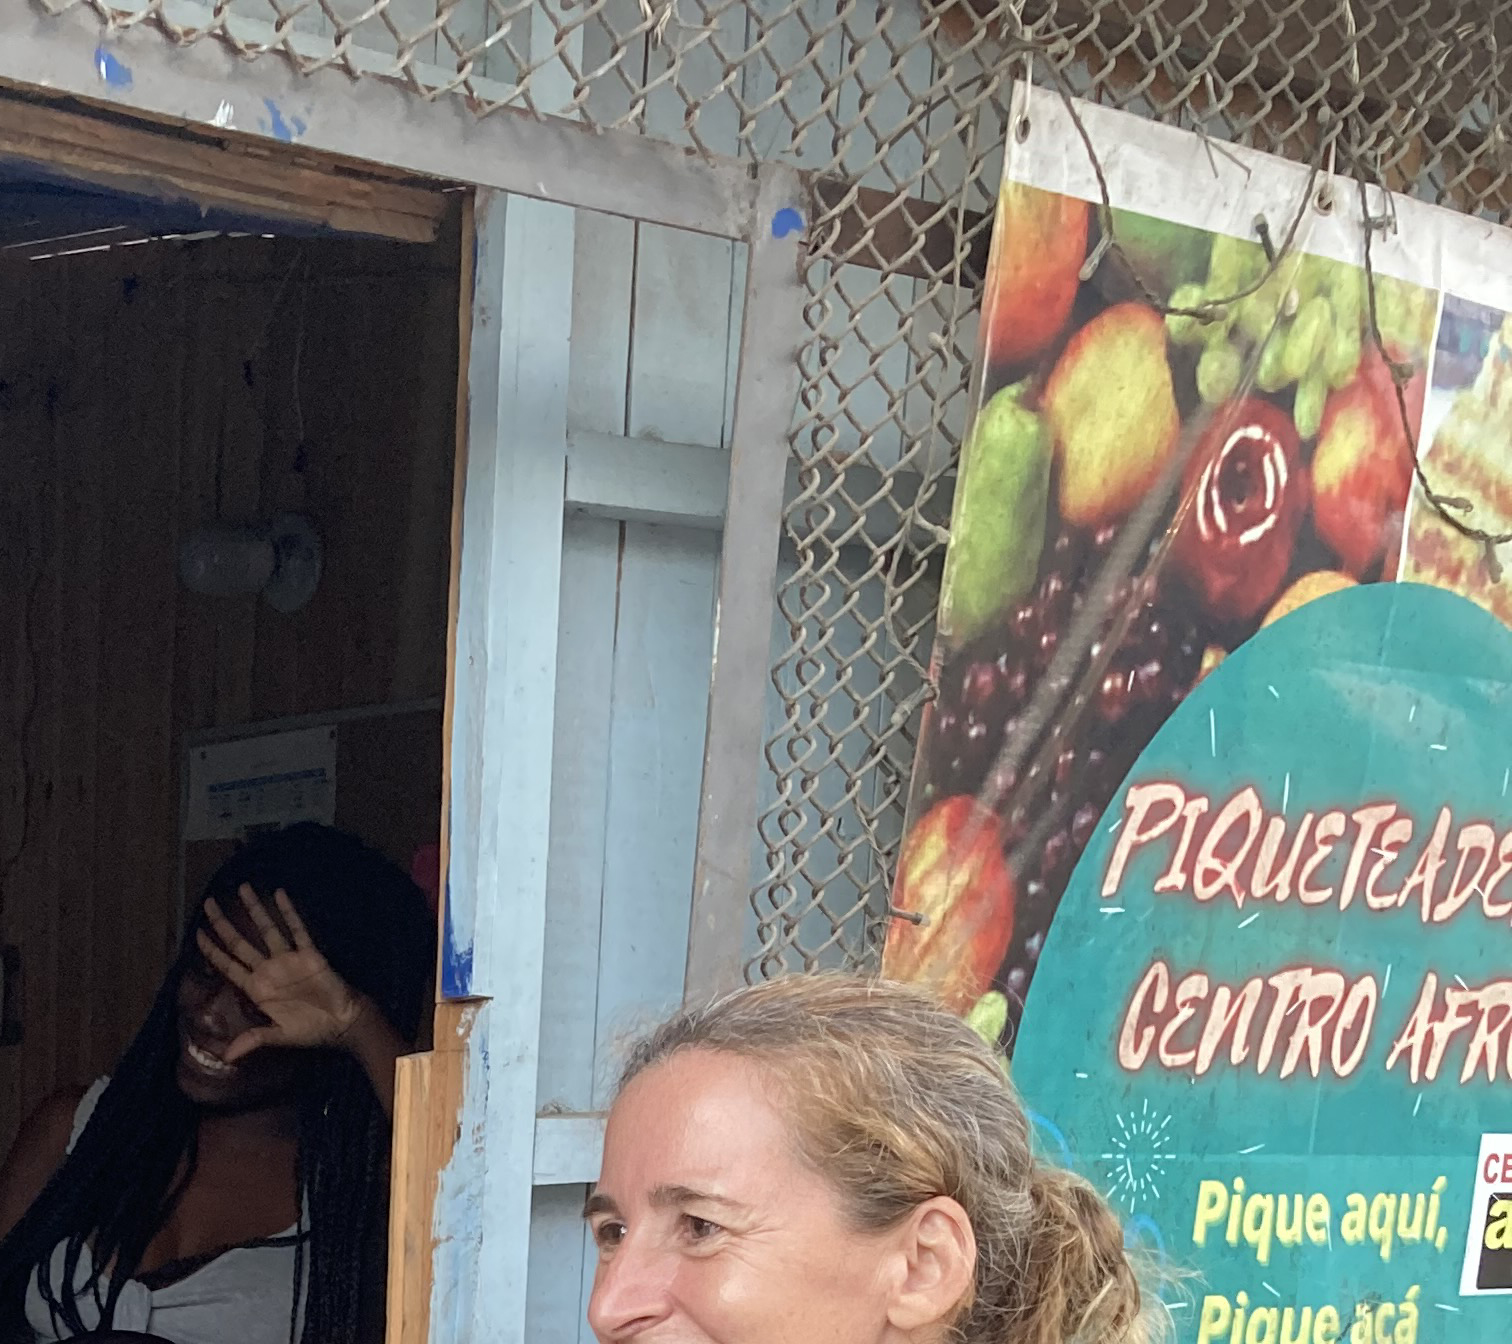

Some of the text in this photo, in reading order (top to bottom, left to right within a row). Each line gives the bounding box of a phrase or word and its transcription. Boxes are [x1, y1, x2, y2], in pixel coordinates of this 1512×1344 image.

[1118, 961, 1512, 1084] CENTRO AFR
[1192, 1175, 1448, 1266] Pique aquí,
